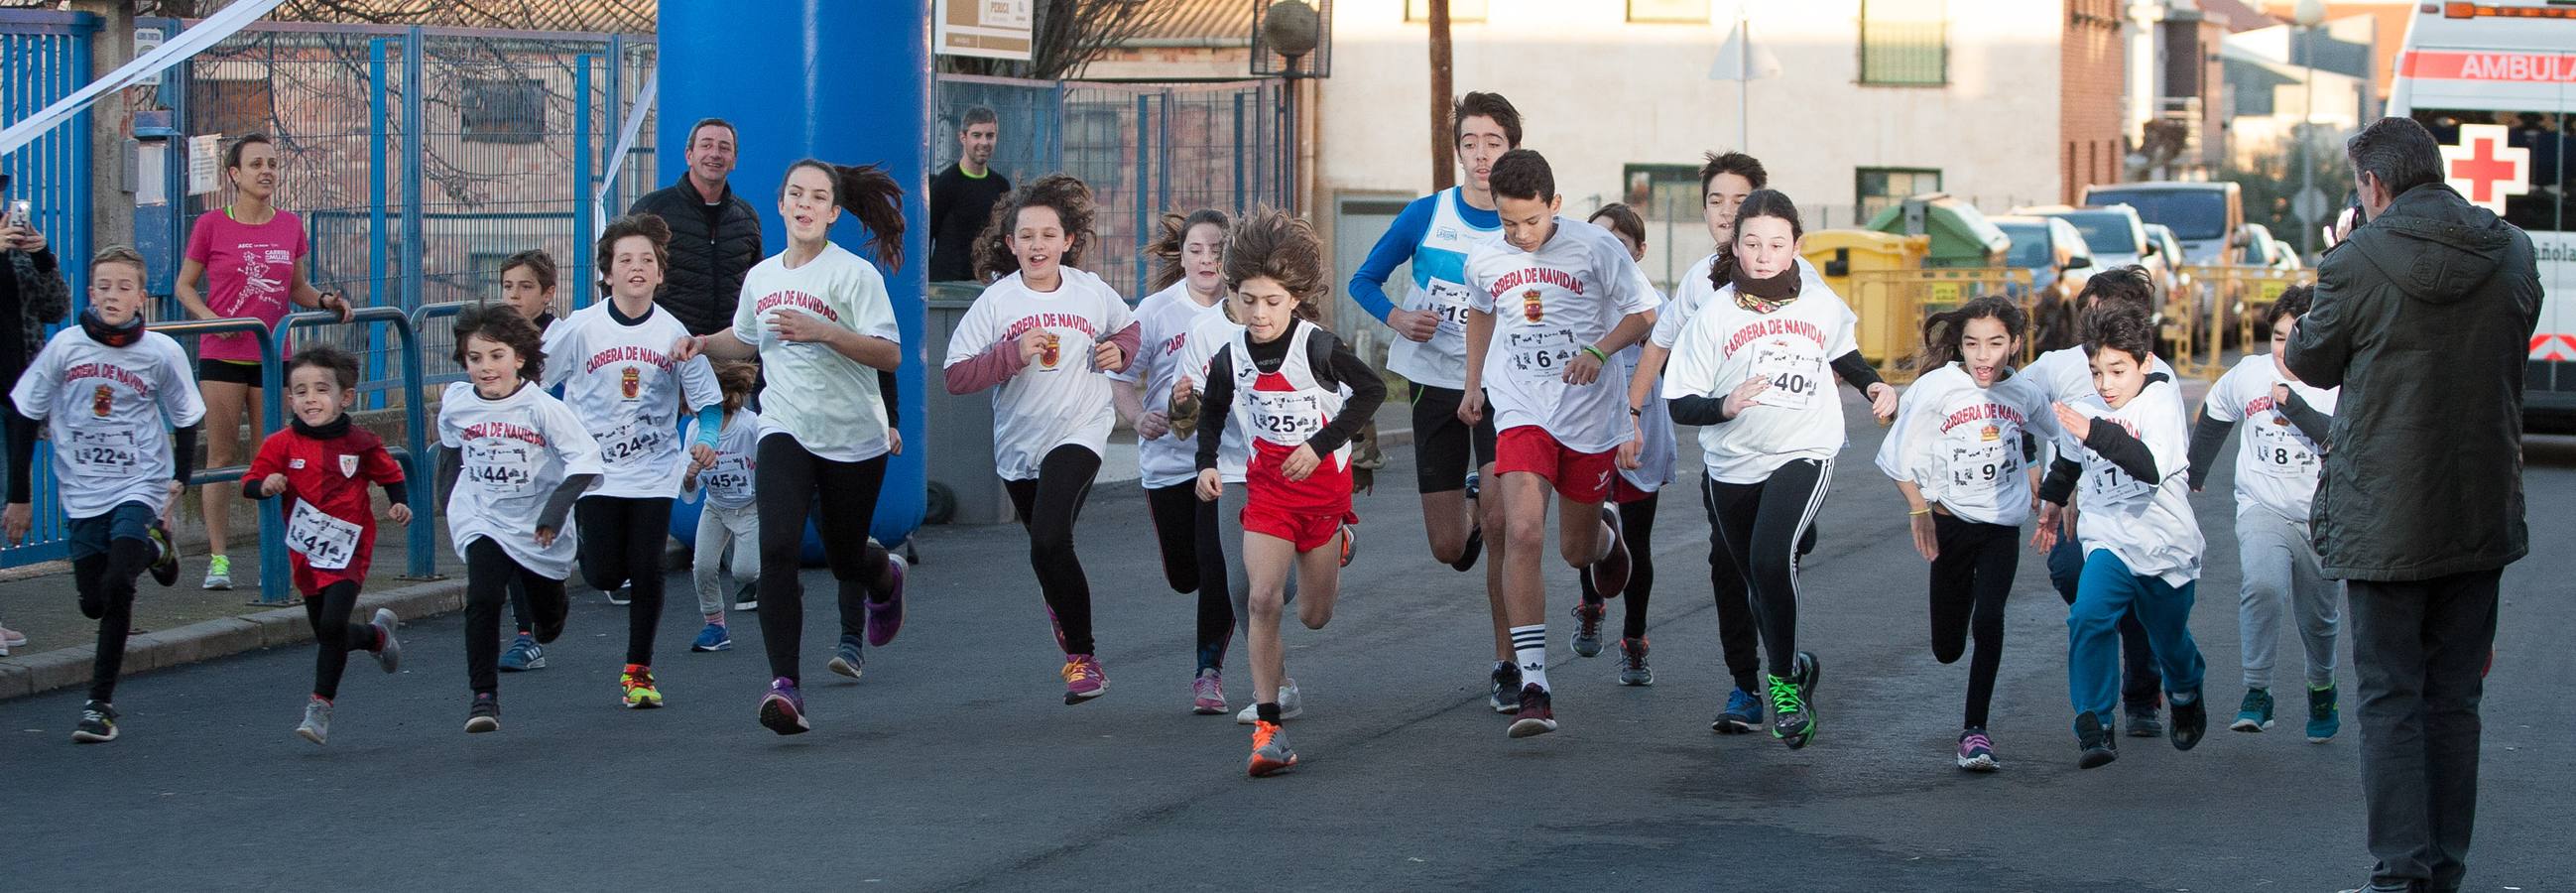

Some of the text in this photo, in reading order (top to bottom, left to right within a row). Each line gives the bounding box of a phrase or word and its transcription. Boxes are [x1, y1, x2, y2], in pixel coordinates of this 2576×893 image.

[2536, 242, 2576, 261] añola
[1490, 267, 1584, 300] ARRERA DE NAVIDAD
[784, 290, 795, 305] DE
[796, 291, 838, 322] NAVIDAD
[1446, 306, 1469, 324] 19
[1043, 313, 1056, 327] DE
[1724, 320, 1768, 360] CARRERA
[1768, 319, 1782, 334] DE
[586, 347, 624, 374] CARRERA
[626, 345, 638, 360] DE
[1536, 350, 1551, 368] 6
[102, 363, 115, 379] DE
[1774, 372, 1804, 393] 40
[1984, 403, 1997, 419] DE
[490, 422, 503, 437] DE
[1268, 415, 1295, 433] 25
[92, 447, 116, 464] 22
[616, 437, 643, 458] 24
[2275, 447, 2288, 464] 8
[484, 466, 509, 483] 44
[710, 473, 731, 487] 45
[1982, 463, 1996, 480] 9
[2104, 466, 2117, 486] 7
[304, 536, 330, 557] 41
